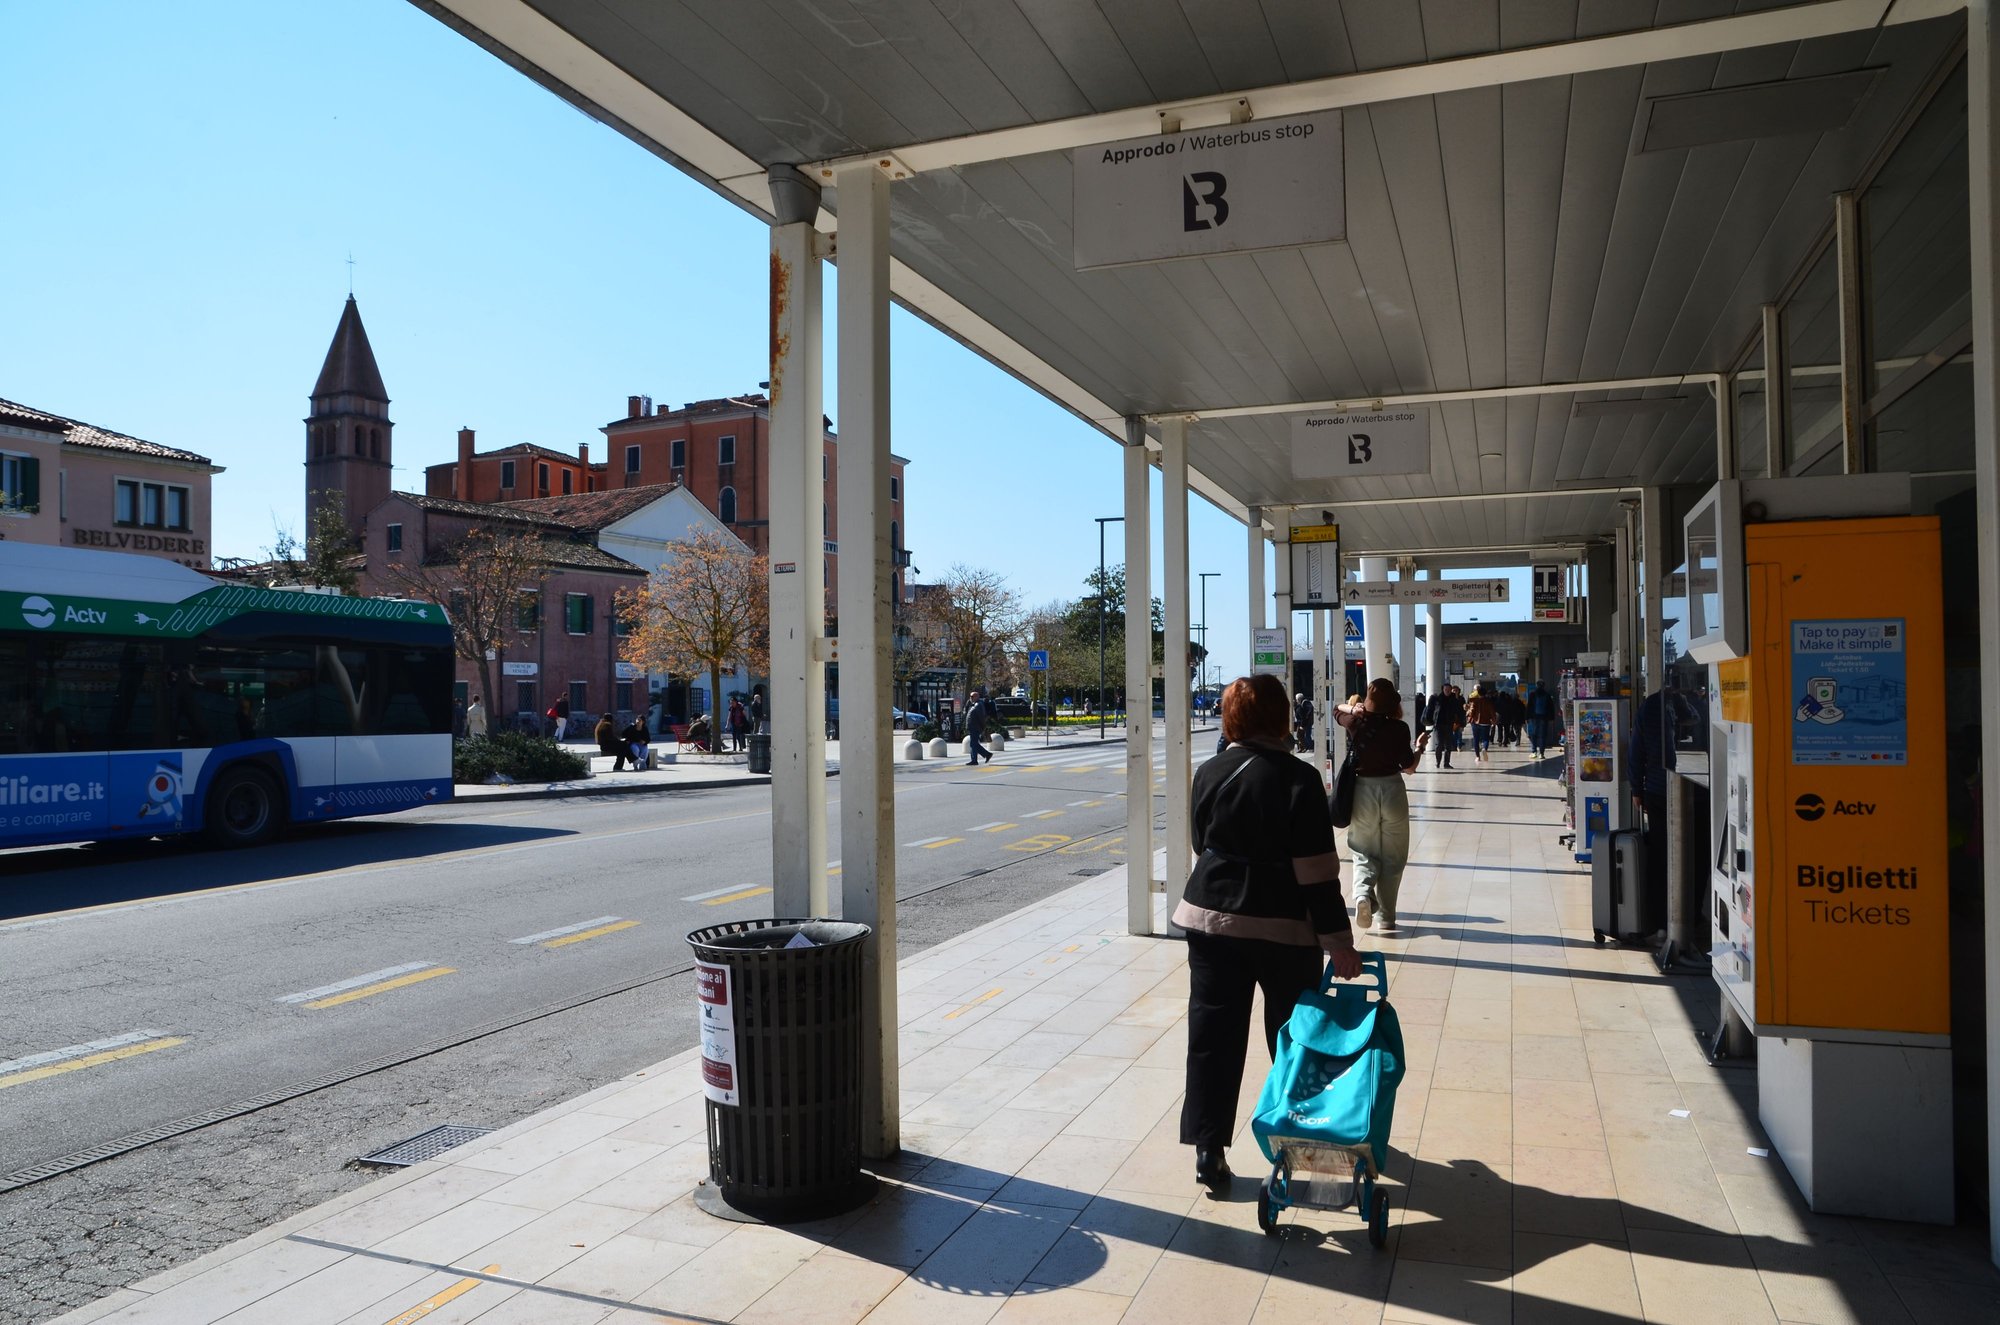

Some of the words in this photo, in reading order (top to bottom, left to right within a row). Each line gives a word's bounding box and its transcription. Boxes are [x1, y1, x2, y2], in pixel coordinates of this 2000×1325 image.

[1102, 142, 1176, 164] Approdo
[1190, 129, 1271, 151] Waterbus
[1275, 123, 1314, 140] stop
[1183, 171, 1229, 232] B
[1305, 417, 1345, 427] Approdo
[1351, 413, 1394, 423] Waterbus
[1395, 413, 1415, 421] stop
[1348, 433, 1372, 464] B
[72, 528, 205, 554] BELVEDERE
[64, 605, 107, 624] Actv
[1800, 627, 1823, 638] Tap
[1826, 628, 1839, 637] to
[1843, 628, 1866, 639] pay
[1800, 639, 1834, 650] Make
[1837, 639, 1846, 650] it
[1849, 638, 1892, 651] simple
[1833, 799, 1876, 815] Actv
[11, 816, 20, 826] e
[24, 811, 92, 826] comprare
[1797, 865, 1917, 893] Biglietti
[1803, 900, 1911, 925] Tickets
[714, 971, 723, 984] ai
